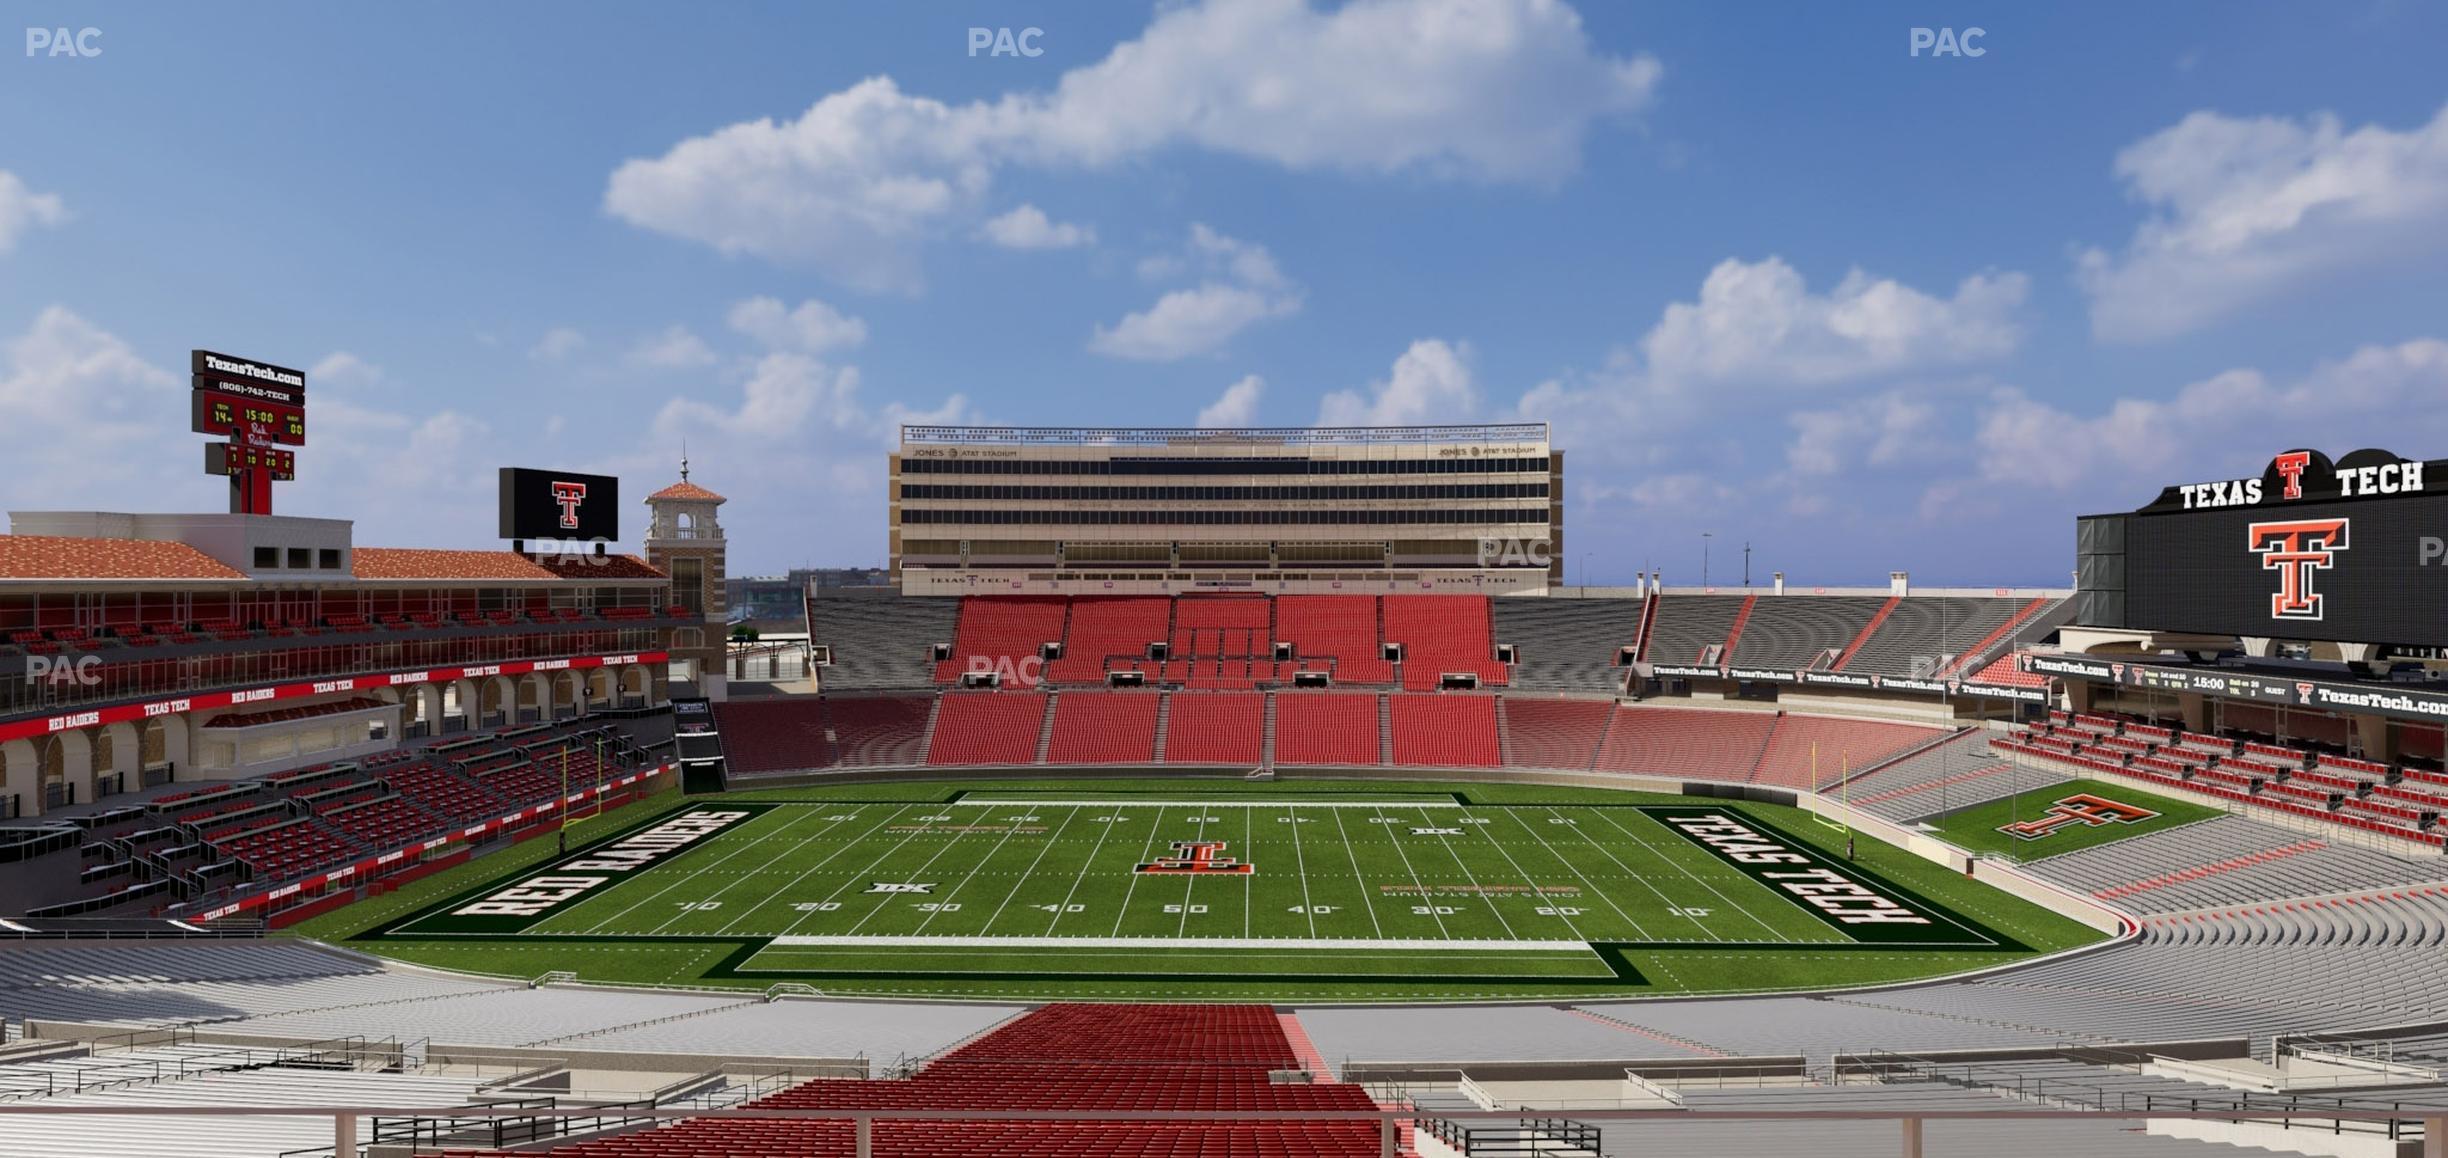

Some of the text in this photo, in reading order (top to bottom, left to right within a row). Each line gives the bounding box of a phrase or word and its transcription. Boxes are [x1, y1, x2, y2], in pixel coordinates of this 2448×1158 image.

[205, 354, 303, 386] TexasTech.com
[218, 381, 291, 401] (806)-742-TECH
[245, 408, 274, 423] 15:00
[913, 449, 945, 458] JONES
[1439, 448, 1467, 457] JONES
[1502, 447, 1536, 455] STADIUM
[2180, 478, 2263, 509] TEXAS
[2336, 462, 2424, 497] TECH
[2034, 659, 2109, 677] TexasTech.com
[313, 678, 354, 694] TEXAS TECH
[2193, 676, 2225, 690] 15:00
[246, 688, 275, 702] RAIDERS
[1961, 684, 2045, 700] TexasTech.com
[144, 698, 190, 717] TEXAS TECH
[48, 711, 99, 732] RED RAIDERS
[451, 811, 751, 916] RED RAIDERS
[1666, 814, 1932, 924] TEXAS TECH
[203, 902, 240, 921] TEXAS TECH
[1163, 904, 1208, 913] 50
